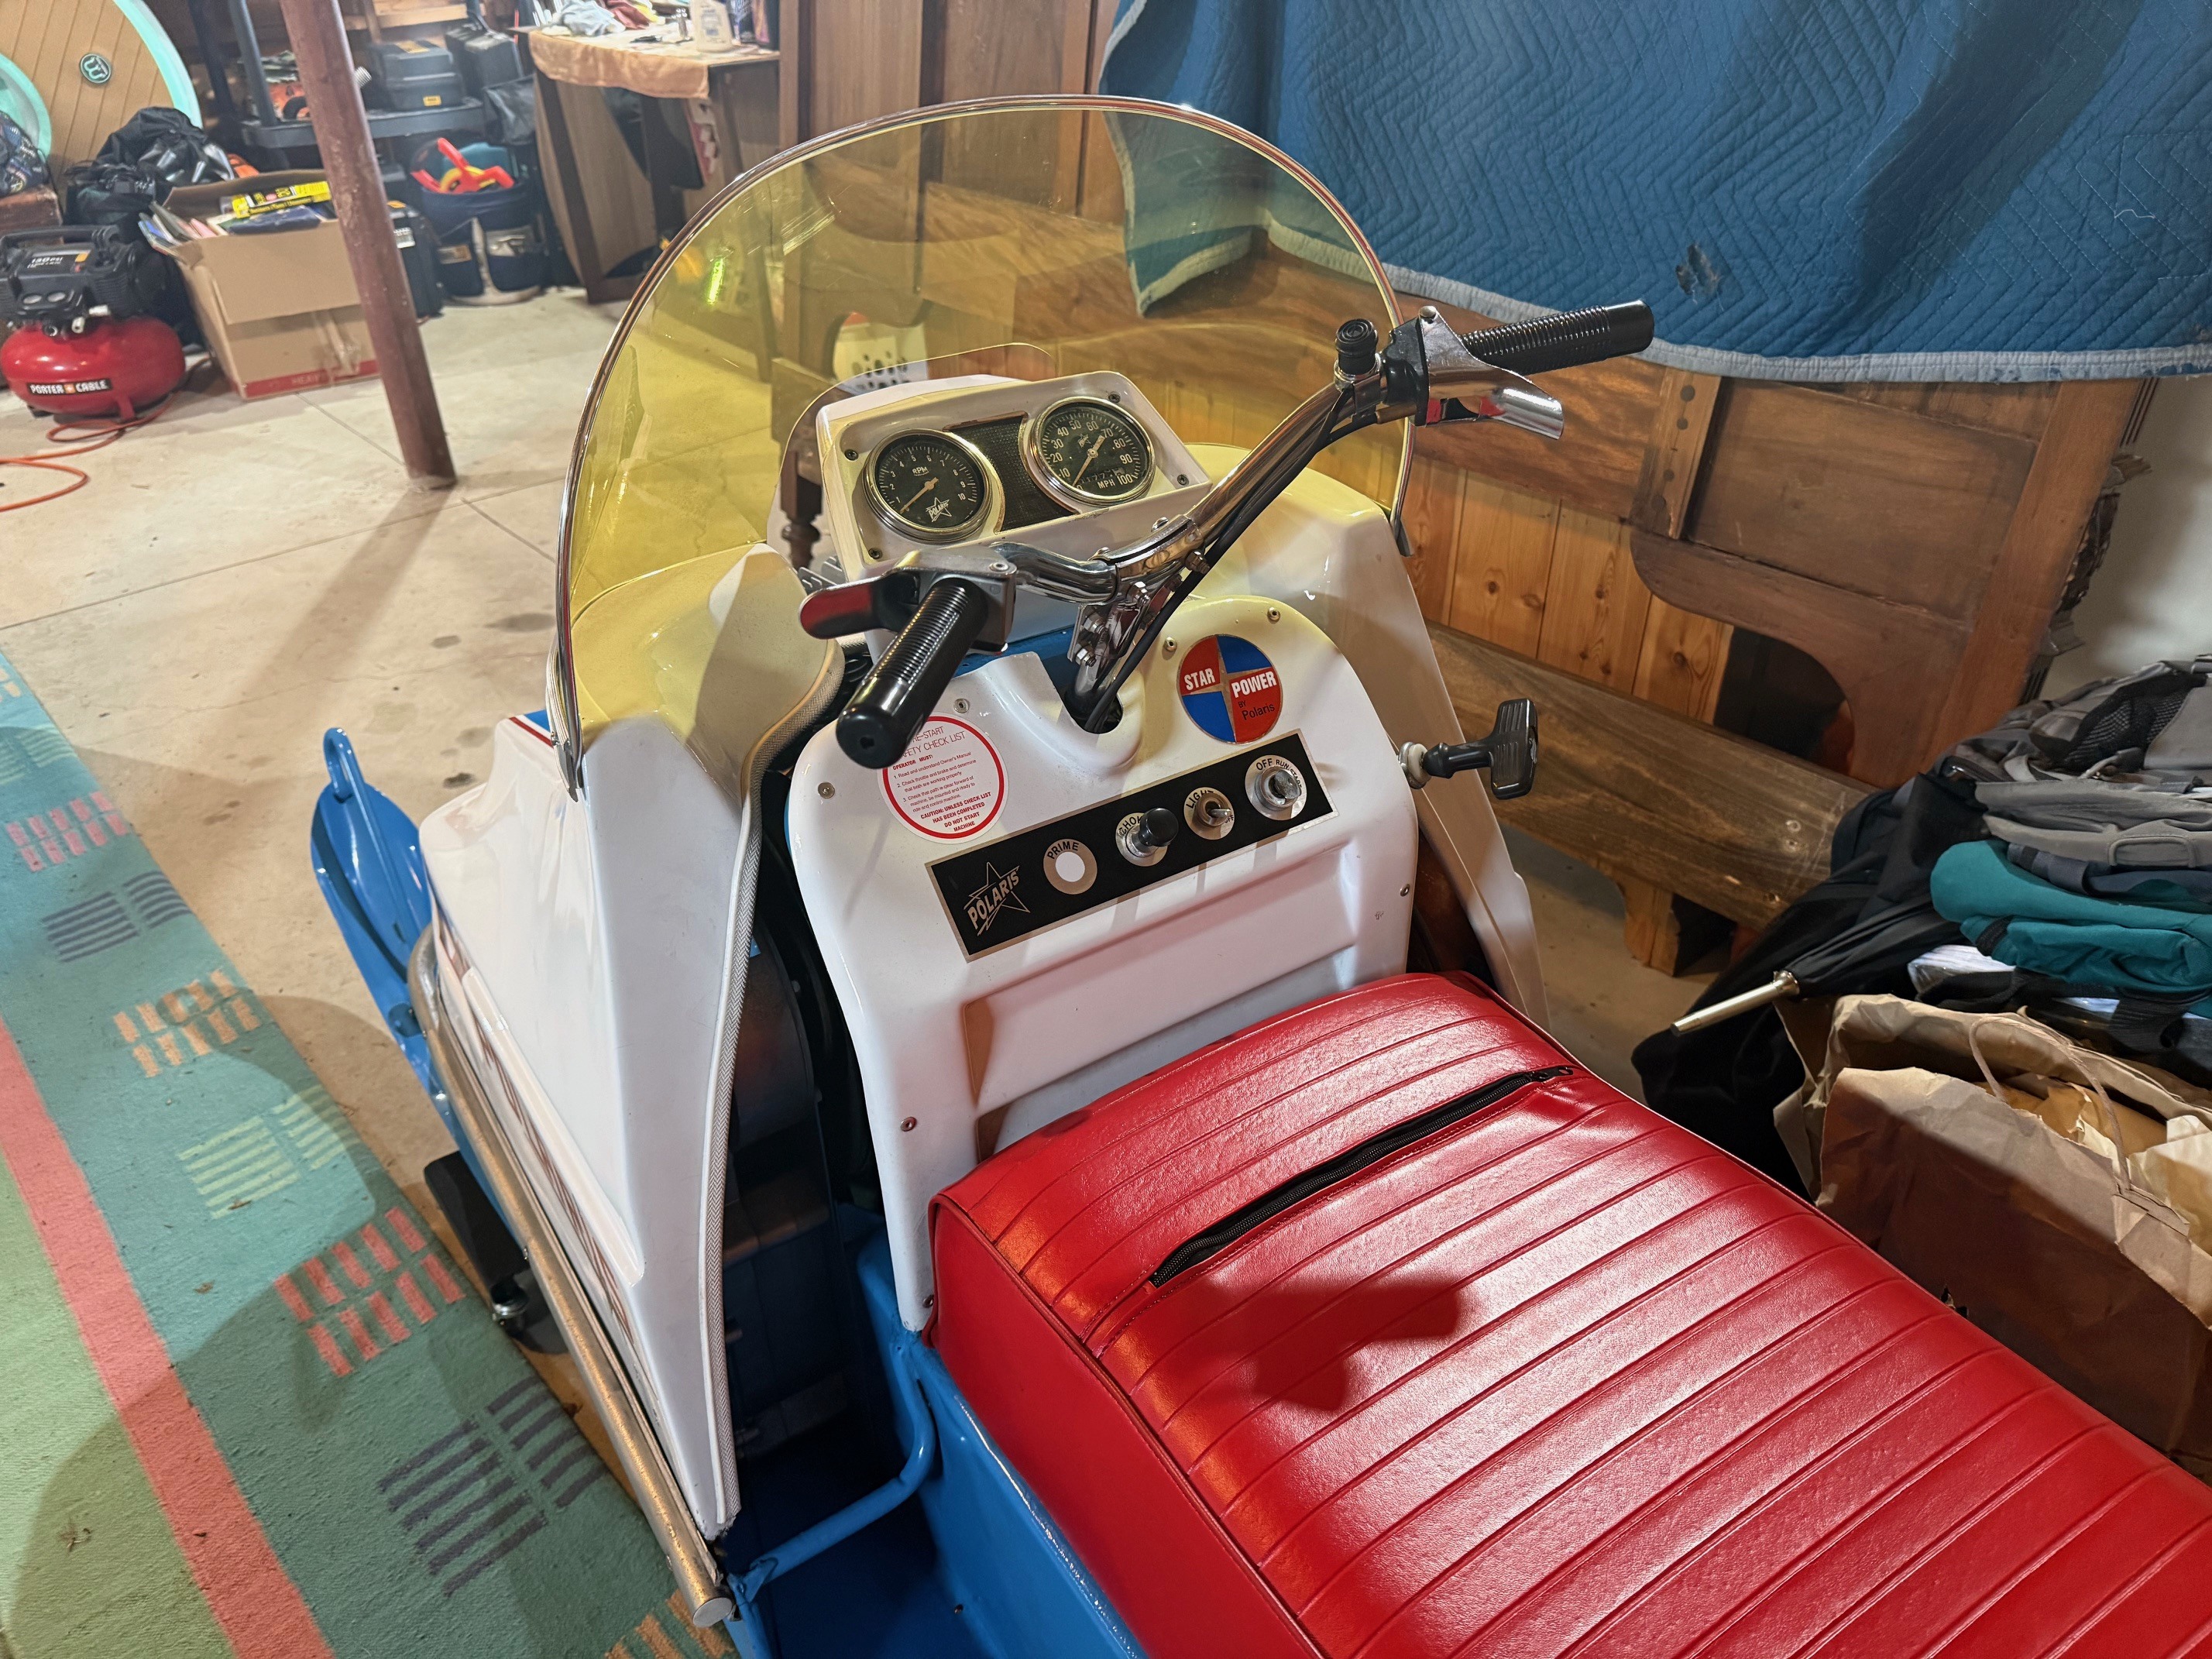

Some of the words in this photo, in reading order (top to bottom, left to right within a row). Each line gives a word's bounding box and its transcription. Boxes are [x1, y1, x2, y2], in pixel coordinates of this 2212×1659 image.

[30, 383, 64, 394] PORTER
[75, 380, 108, 393] CABLE
[1069, 420, 1082, 430] 50
[1086, 421, 1099, 431] 60
[1057, 427, 1070, 436] 40
[1101, 428, 1114, 438] 70
[1051, 438, 1064, 449] 30
[1114, 438, 1126, 448] 80
[1050, 452, 1063, 463] 20
[1120, 454, 1132, 465] 90
[1060, 468, 1070, 478] 10
[1097, 479, 1115, 489] MPH
[1117, 473, 1133, 486] 100
[1183, 668, 1216, 691] STAR
[1231, 671, 1277, 698] POWER
[1238, 700, 1247, 709] BY
[1242, 702, 1276, 721] Polaris
[913, 726, 944, 743] E-START
[924, 737, 950, 750] CHECK
[950, 730, 965, 743] LIST
[893, 760, 916, 771] OPERATOR
[919, 762, 940, 772] understand
[940, 756, 957, 764] Owner's
[1255, 758, 1273, 770] OFF
[929, 776, 946, 785] working
[946, 771, 962, 780] properly
[953, 777, 969, 785] forward
[934, 790, 951, 799] mounted
[1186, 790, 1214, 809] LIG
[920, 809, 944, 819] CAUTION:
[944, 801, 963, 812] UNLESS
[963, 795, 981, 805] CHECK
[943, 812, 957, 820] BEEN
[957, 802, 985, 815] COMPLETED
[964, 812, 980, 821] START
[953, 821, 975, 832] MACHINE
[1047, 841, 1079, 860] PRIME
[967, 871, 1019, 930] POLARIS
